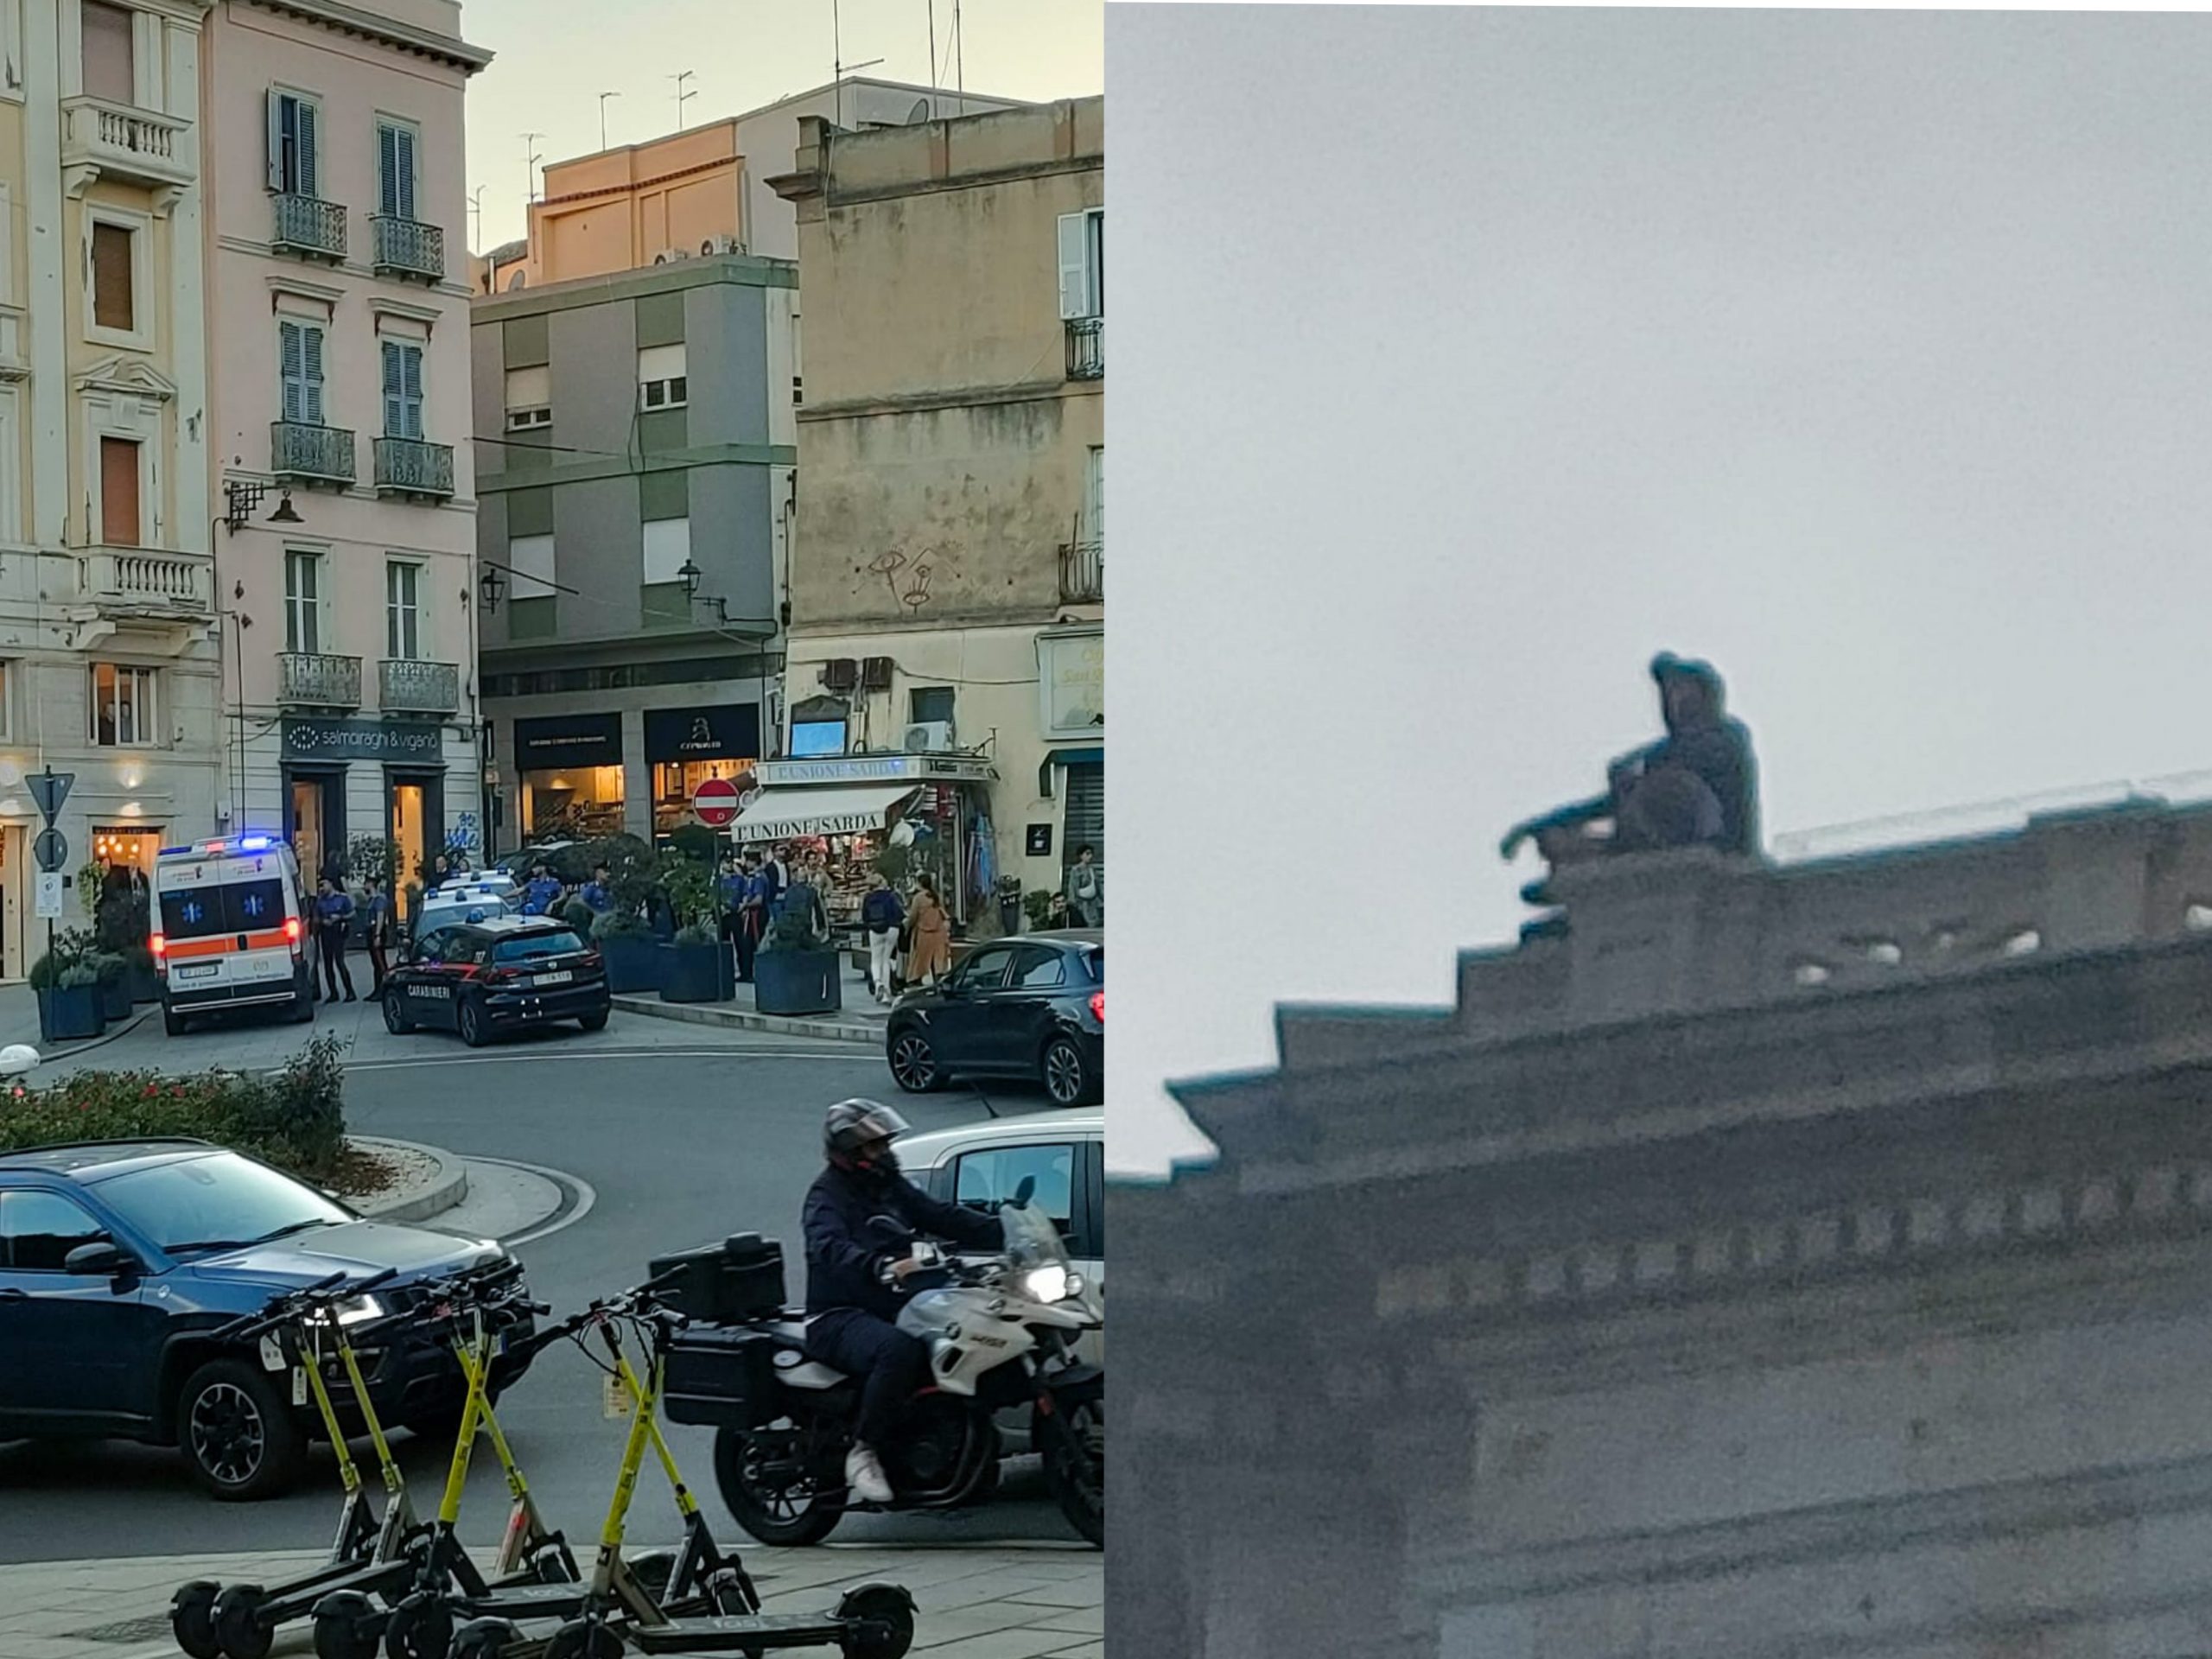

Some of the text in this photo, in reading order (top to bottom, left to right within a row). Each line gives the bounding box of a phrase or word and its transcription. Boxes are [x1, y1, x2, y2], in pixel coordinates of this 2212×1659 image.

[390, 730, 398, 747] &
[736, 814, 878, 842] L'UNIONE SARDA
[408, 984, 451, 1000] CARABINIERI
